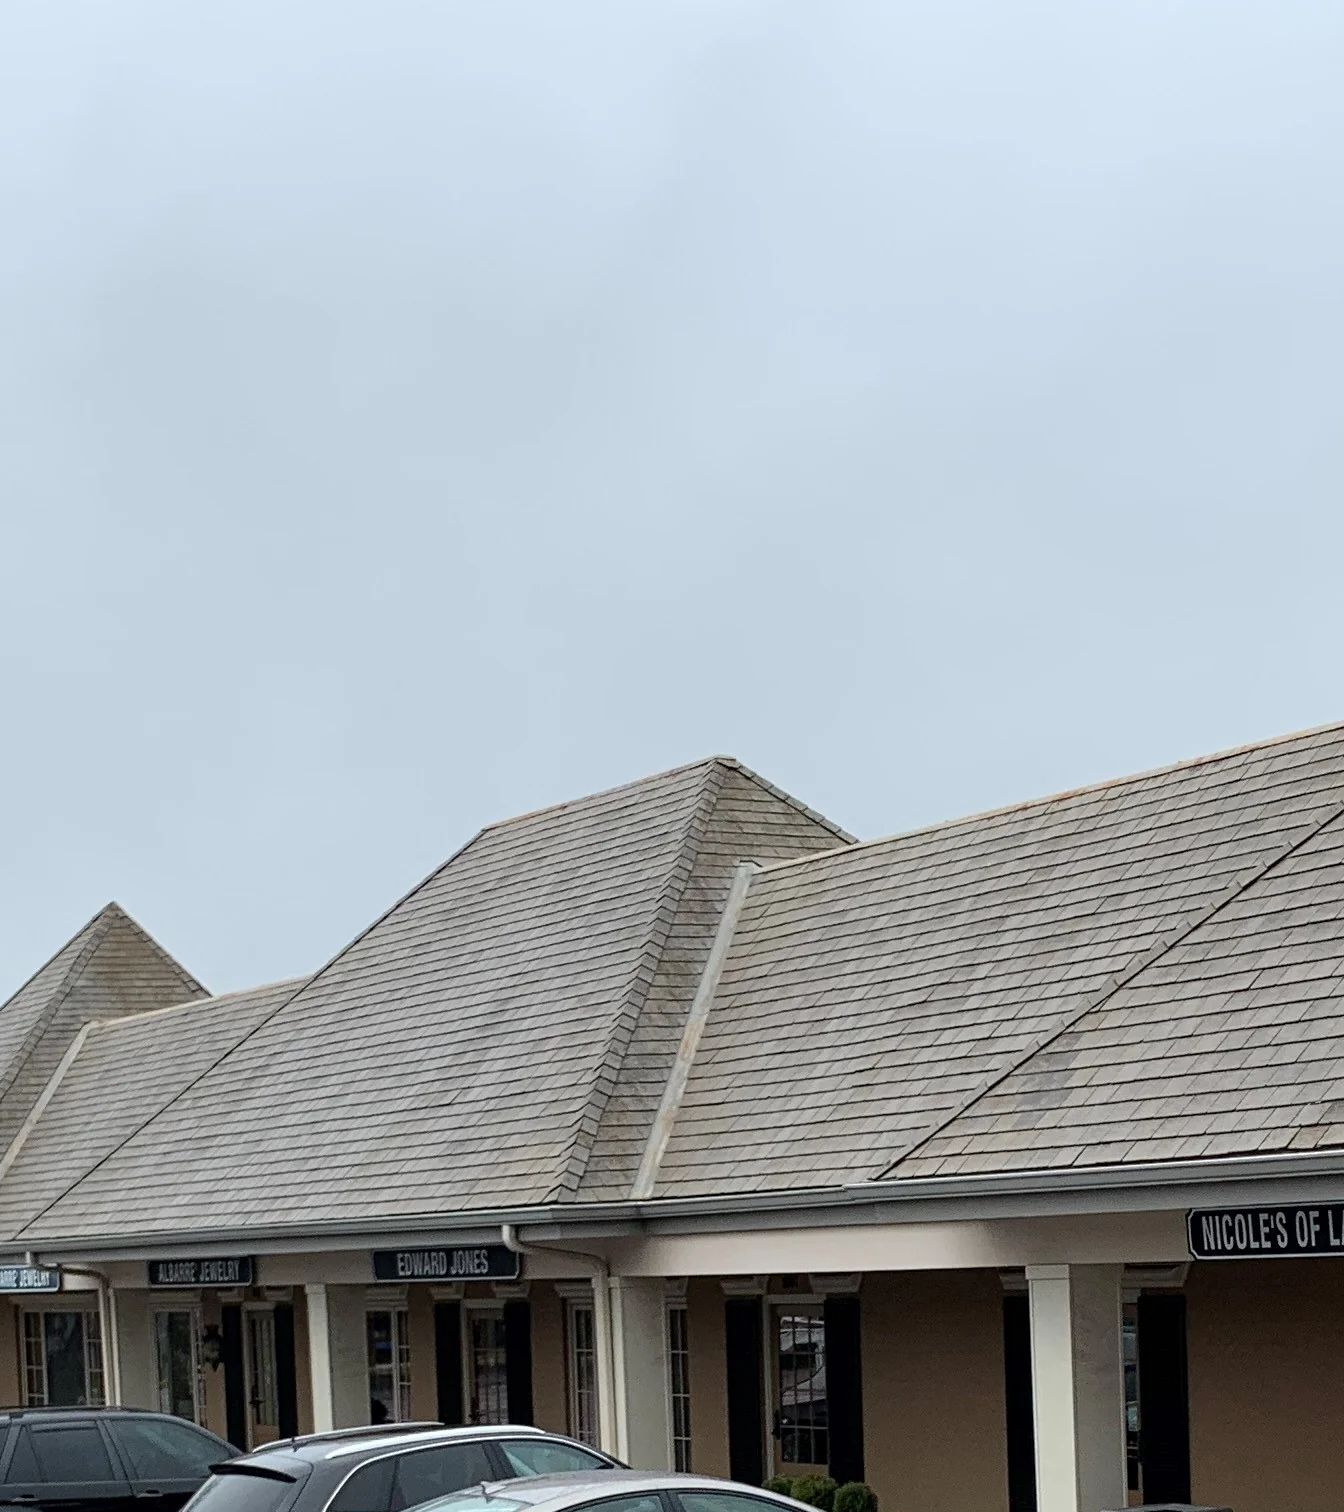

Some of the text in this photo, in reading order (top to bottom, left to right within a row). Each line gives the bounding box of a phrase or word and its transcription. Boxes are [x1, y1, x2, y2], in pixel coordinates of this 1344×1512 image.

[1202, 1213, 1287, 1250] NICOLE'S
[1295, 1211, 1321, 1248] OF
[199, 1260, 240, 1281] JEWELRY
[397, 1249, 489, 1276] EDWARD JONES
